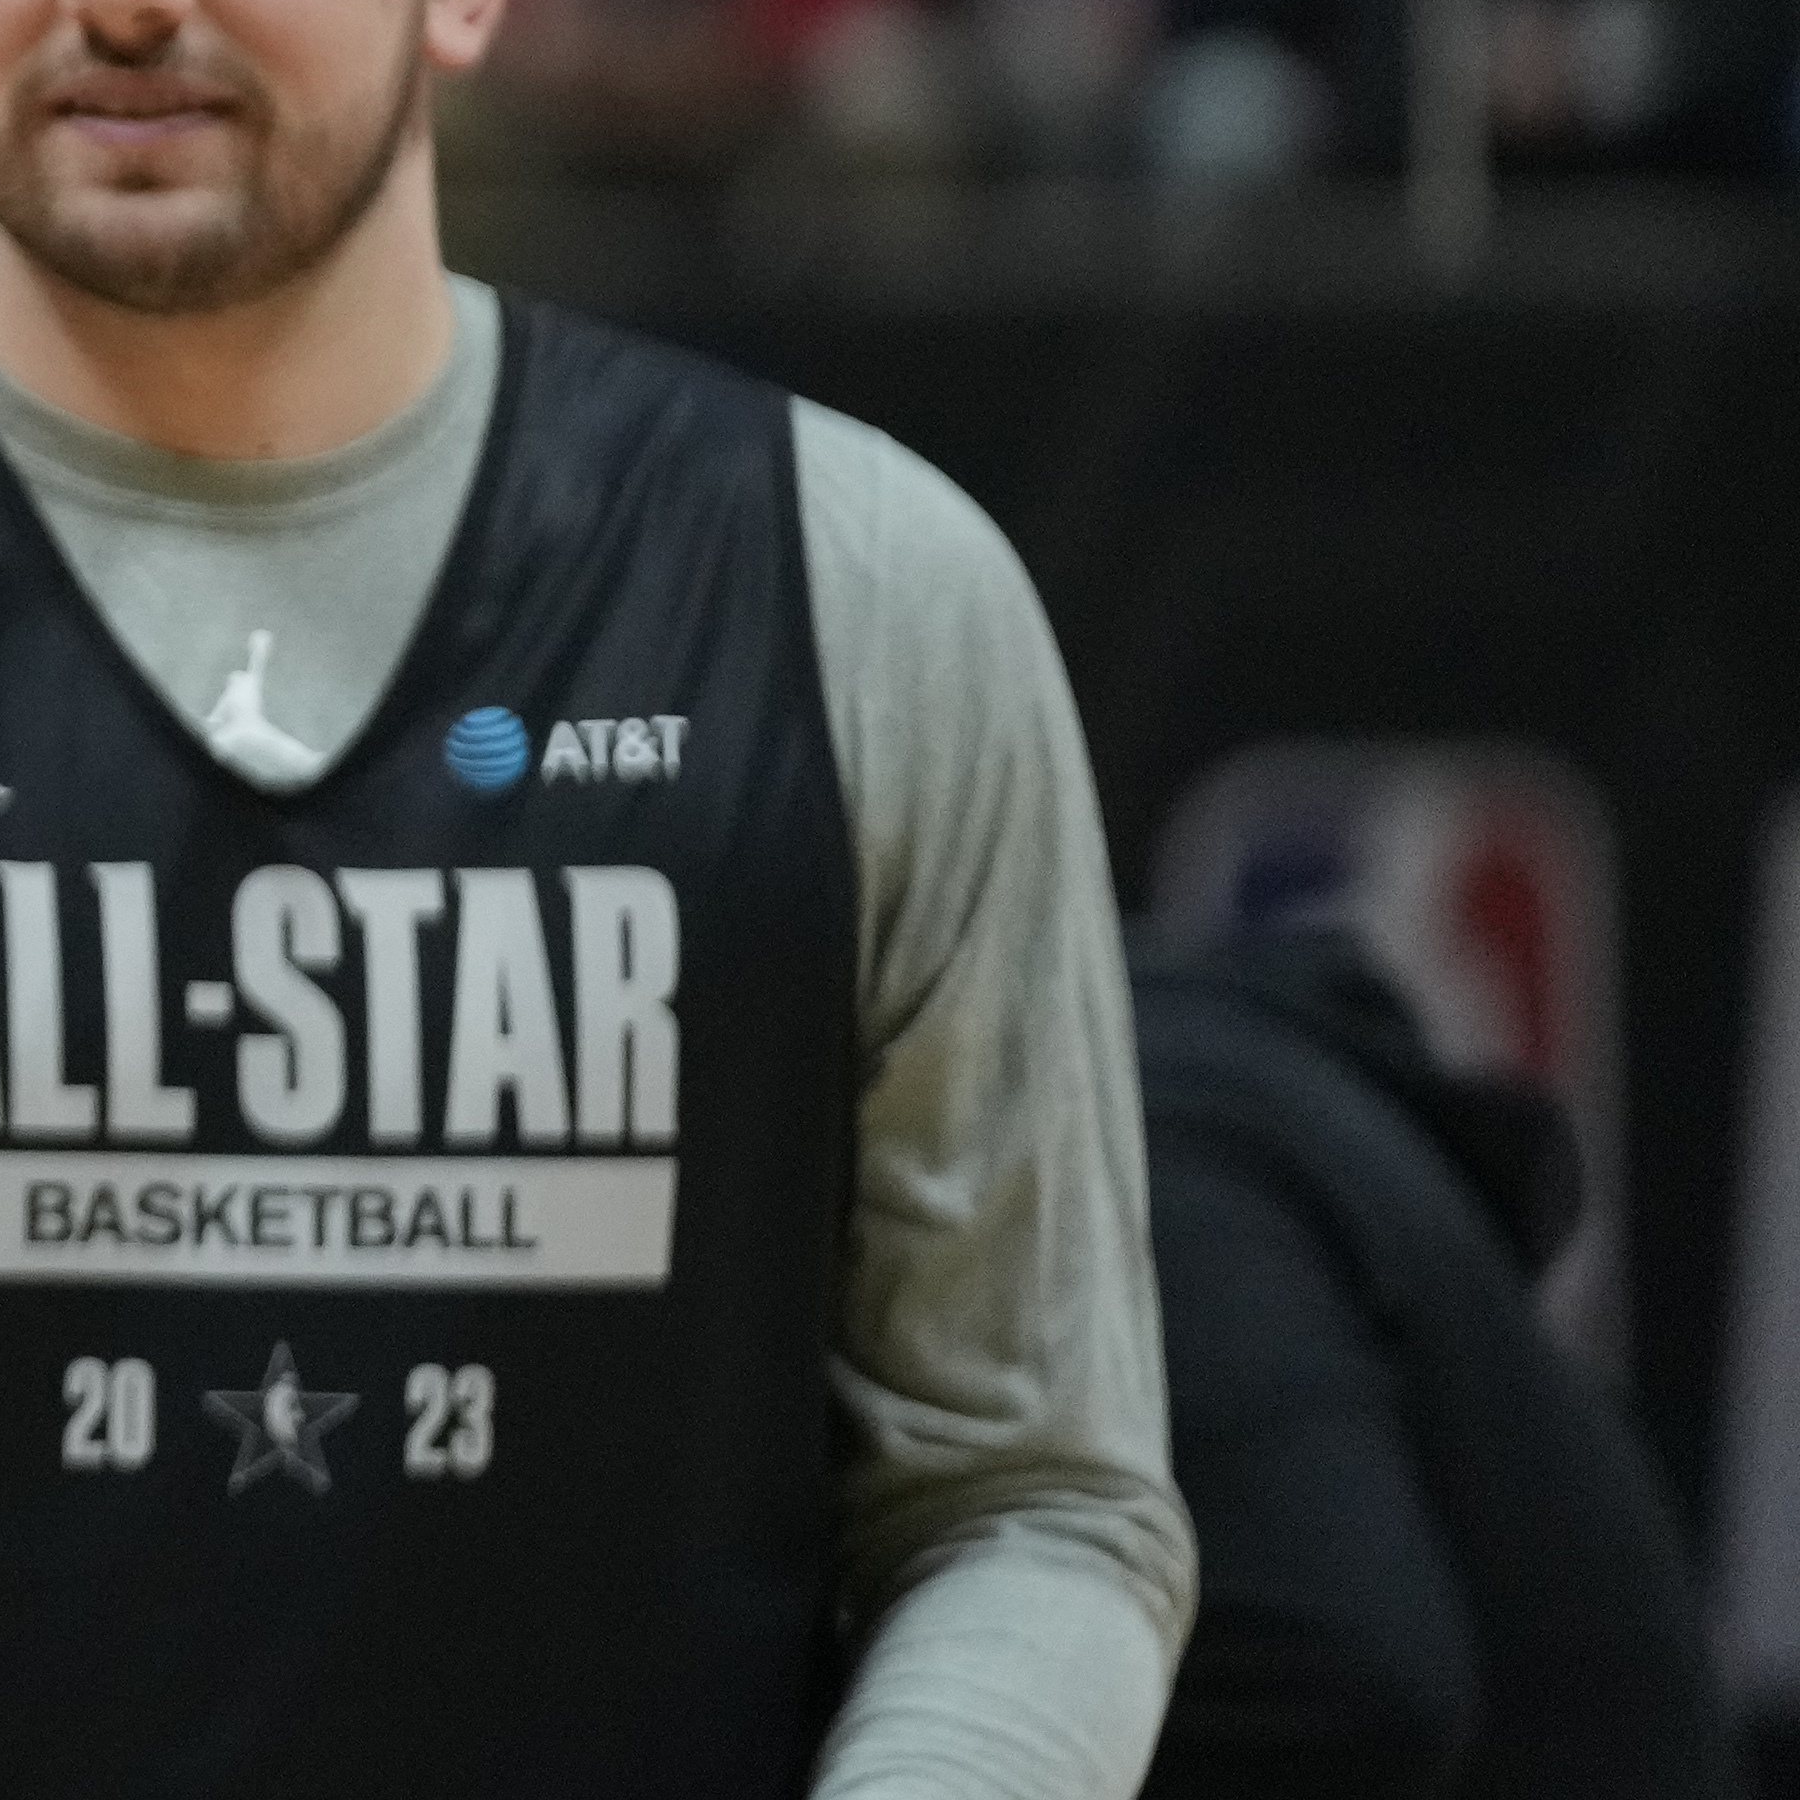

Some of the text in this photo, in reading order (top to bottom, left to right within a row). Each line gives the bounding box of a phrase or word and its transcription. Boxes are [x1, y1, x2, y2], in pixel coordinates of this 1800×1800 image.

[540, 713, 690, 784] AT&T
[23, 1180, 539, 1251] BASKETBALL
[61, 1355, 496, 1477] 20 23
